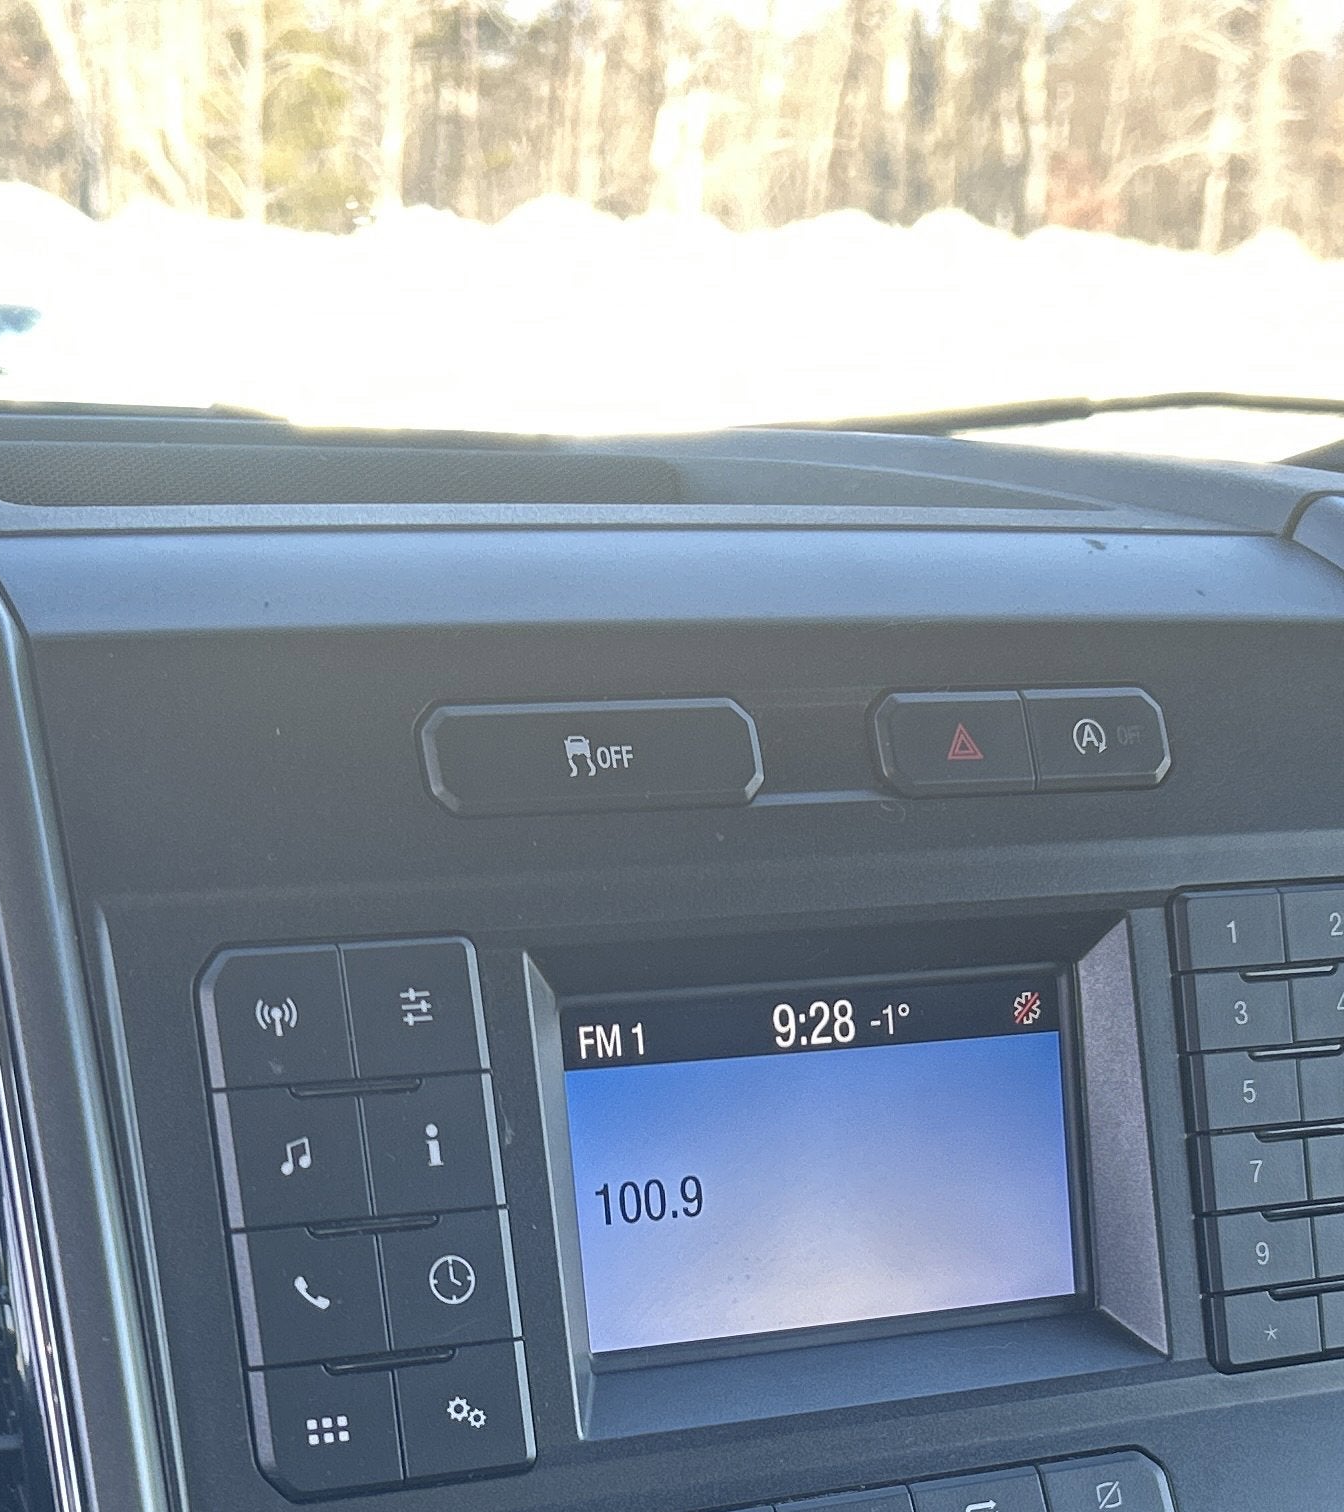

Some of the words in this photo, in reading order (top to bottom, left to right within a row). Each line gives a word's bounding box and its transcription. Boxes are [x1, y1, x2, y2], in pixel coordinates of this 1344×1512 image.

[596, 745, 634, 769] OFF
[1227, 920, 1238, 944] 1
[1329, 912, 1344, 937] 2
[772, 999, 856, 1048] 9:28
[1234, 1001, 1249, 1025] 3
[577, 1024, 623, 1060] FM
[631, 1022, 647, 1056] 1
[1242, 1079, 1257, 1104] 5
[1249, 1159, 1264, 1184] 7
[594, 1174, 704, 1227] 100.9
[1255, 1241, 1270, 1266] 9
